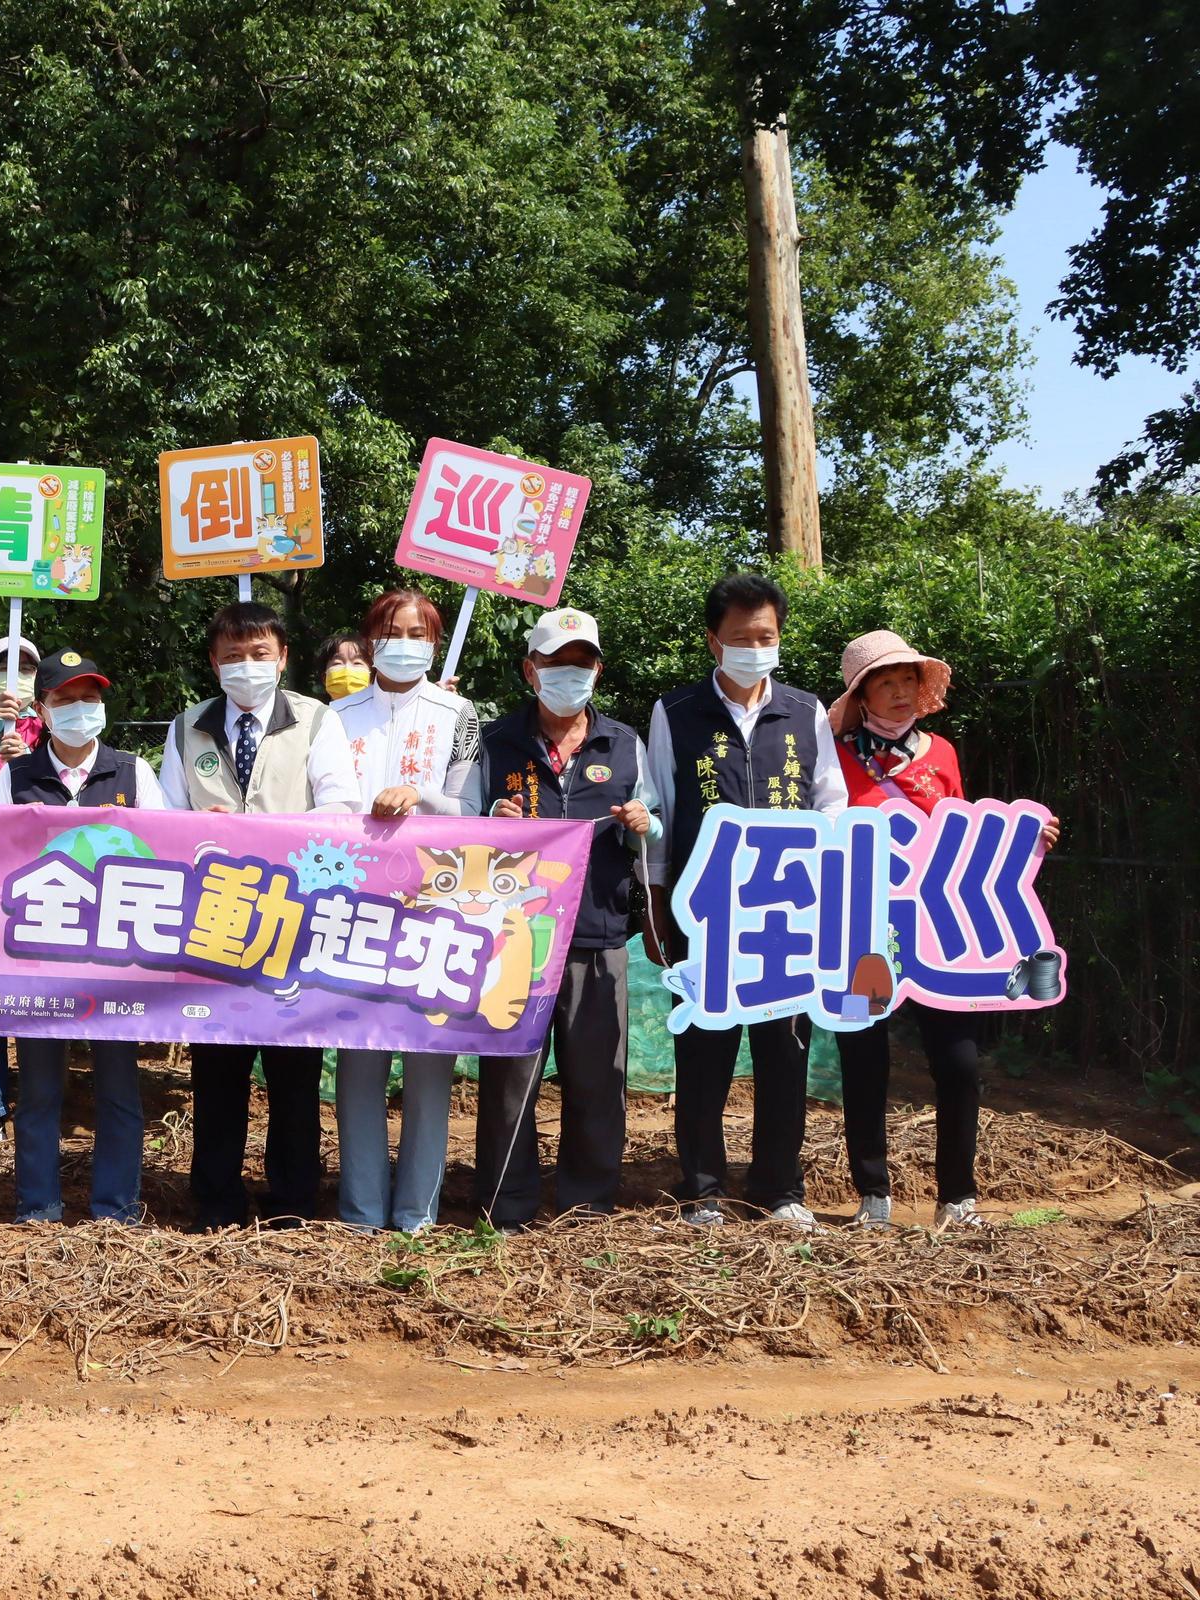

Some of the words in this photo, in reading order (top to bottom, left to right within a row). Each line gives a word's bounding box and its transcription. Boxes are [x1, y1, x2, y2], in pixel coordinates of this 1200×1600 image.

[82, 480, 97, 523] 清除積水
[181, 466, 253, 543] 倒
[425, 464, 515, 552] 巡
[535, 482, 563, 545] 避免戶外積水
[401, 730, 421, 785] 蕭詠
[712, 732, 729, 758] 秘書
[10, 859, 484, 1004] 全民動起來
[689, 820, 875, 1015] 倒
[888, 811, 1043, 999] 巡
[103, 1001, 145, 1016] 關心您
[186, 1006, 207, 1017] 廣告
